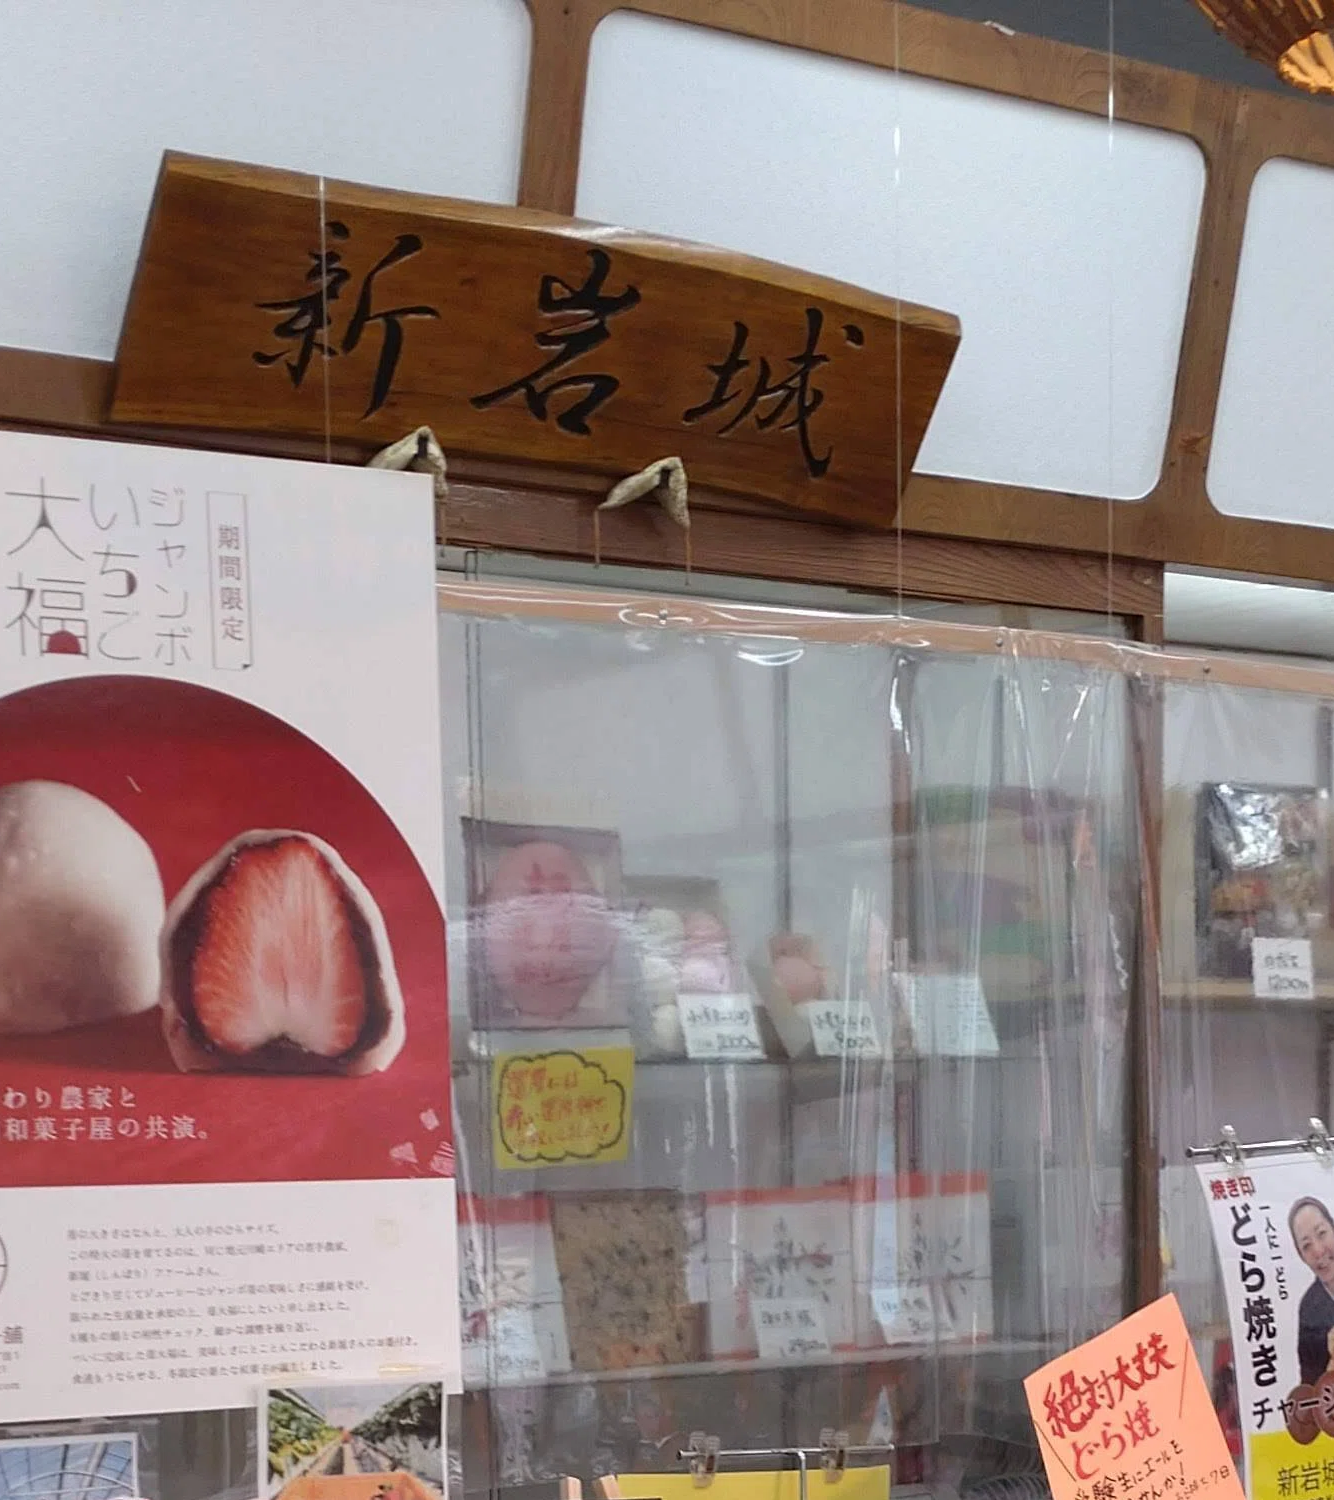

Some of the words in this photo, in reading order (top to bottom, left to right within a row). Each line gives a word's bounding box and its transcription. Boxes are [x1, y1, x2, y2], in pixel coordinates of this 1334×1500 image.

[253, 220, 864, 478] 新岩城
[5, 477, 91, 659] 大福
[89, 484, 142, 661] いちご
[150, 487, 193, 667] ジャンボ
[217, 524, 245, 642] 期間限定
[1209, 1176, 1257, 1199] 焼き印
[1229, 1204, 1278, 1387] どら焼き
[1043, 1332, 1176, 1440] 絶対大丈夫
[1072, 1399, 1162, 1481] どら焼
